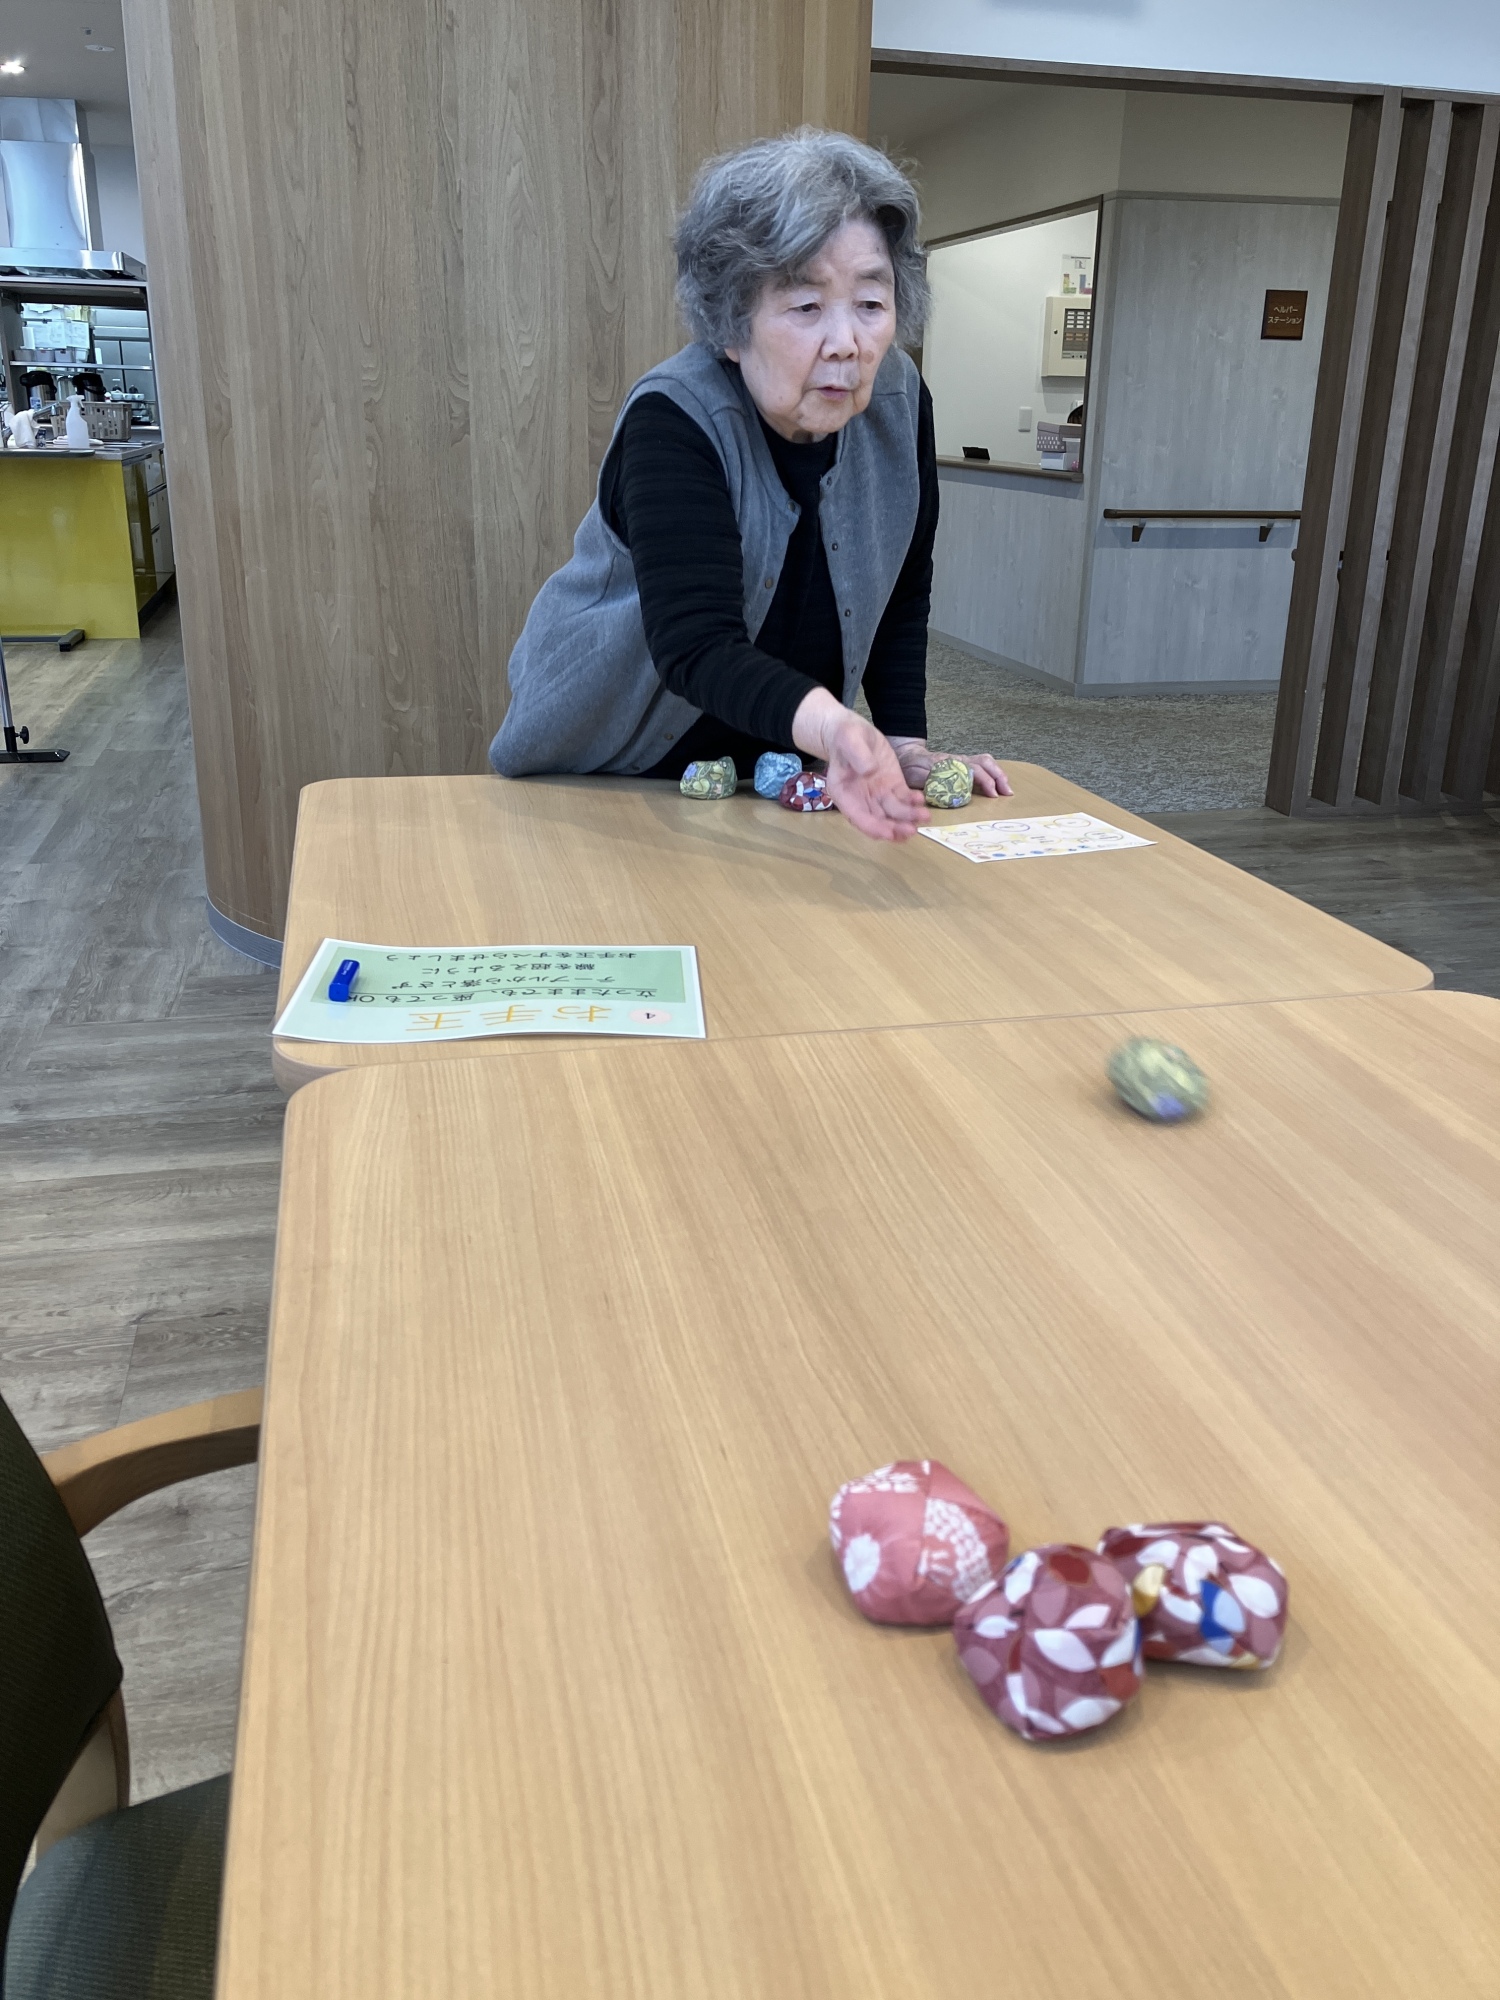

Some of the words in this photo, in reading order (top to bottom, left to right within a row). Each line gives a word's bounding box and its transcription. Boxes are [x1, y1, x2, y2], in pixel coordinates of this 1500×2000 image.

[1268, 316, 1302, 324] ステーション
[386, 951, 637, 961] お手玉をすべらせましょう
[422, 963, 595, 974] 線を超えるように
[391, 976, 615, 989] テーブルから落とさず
[406, 1004, 612, 1031] お手玉
[645, 1012, 656, 1020] 4
